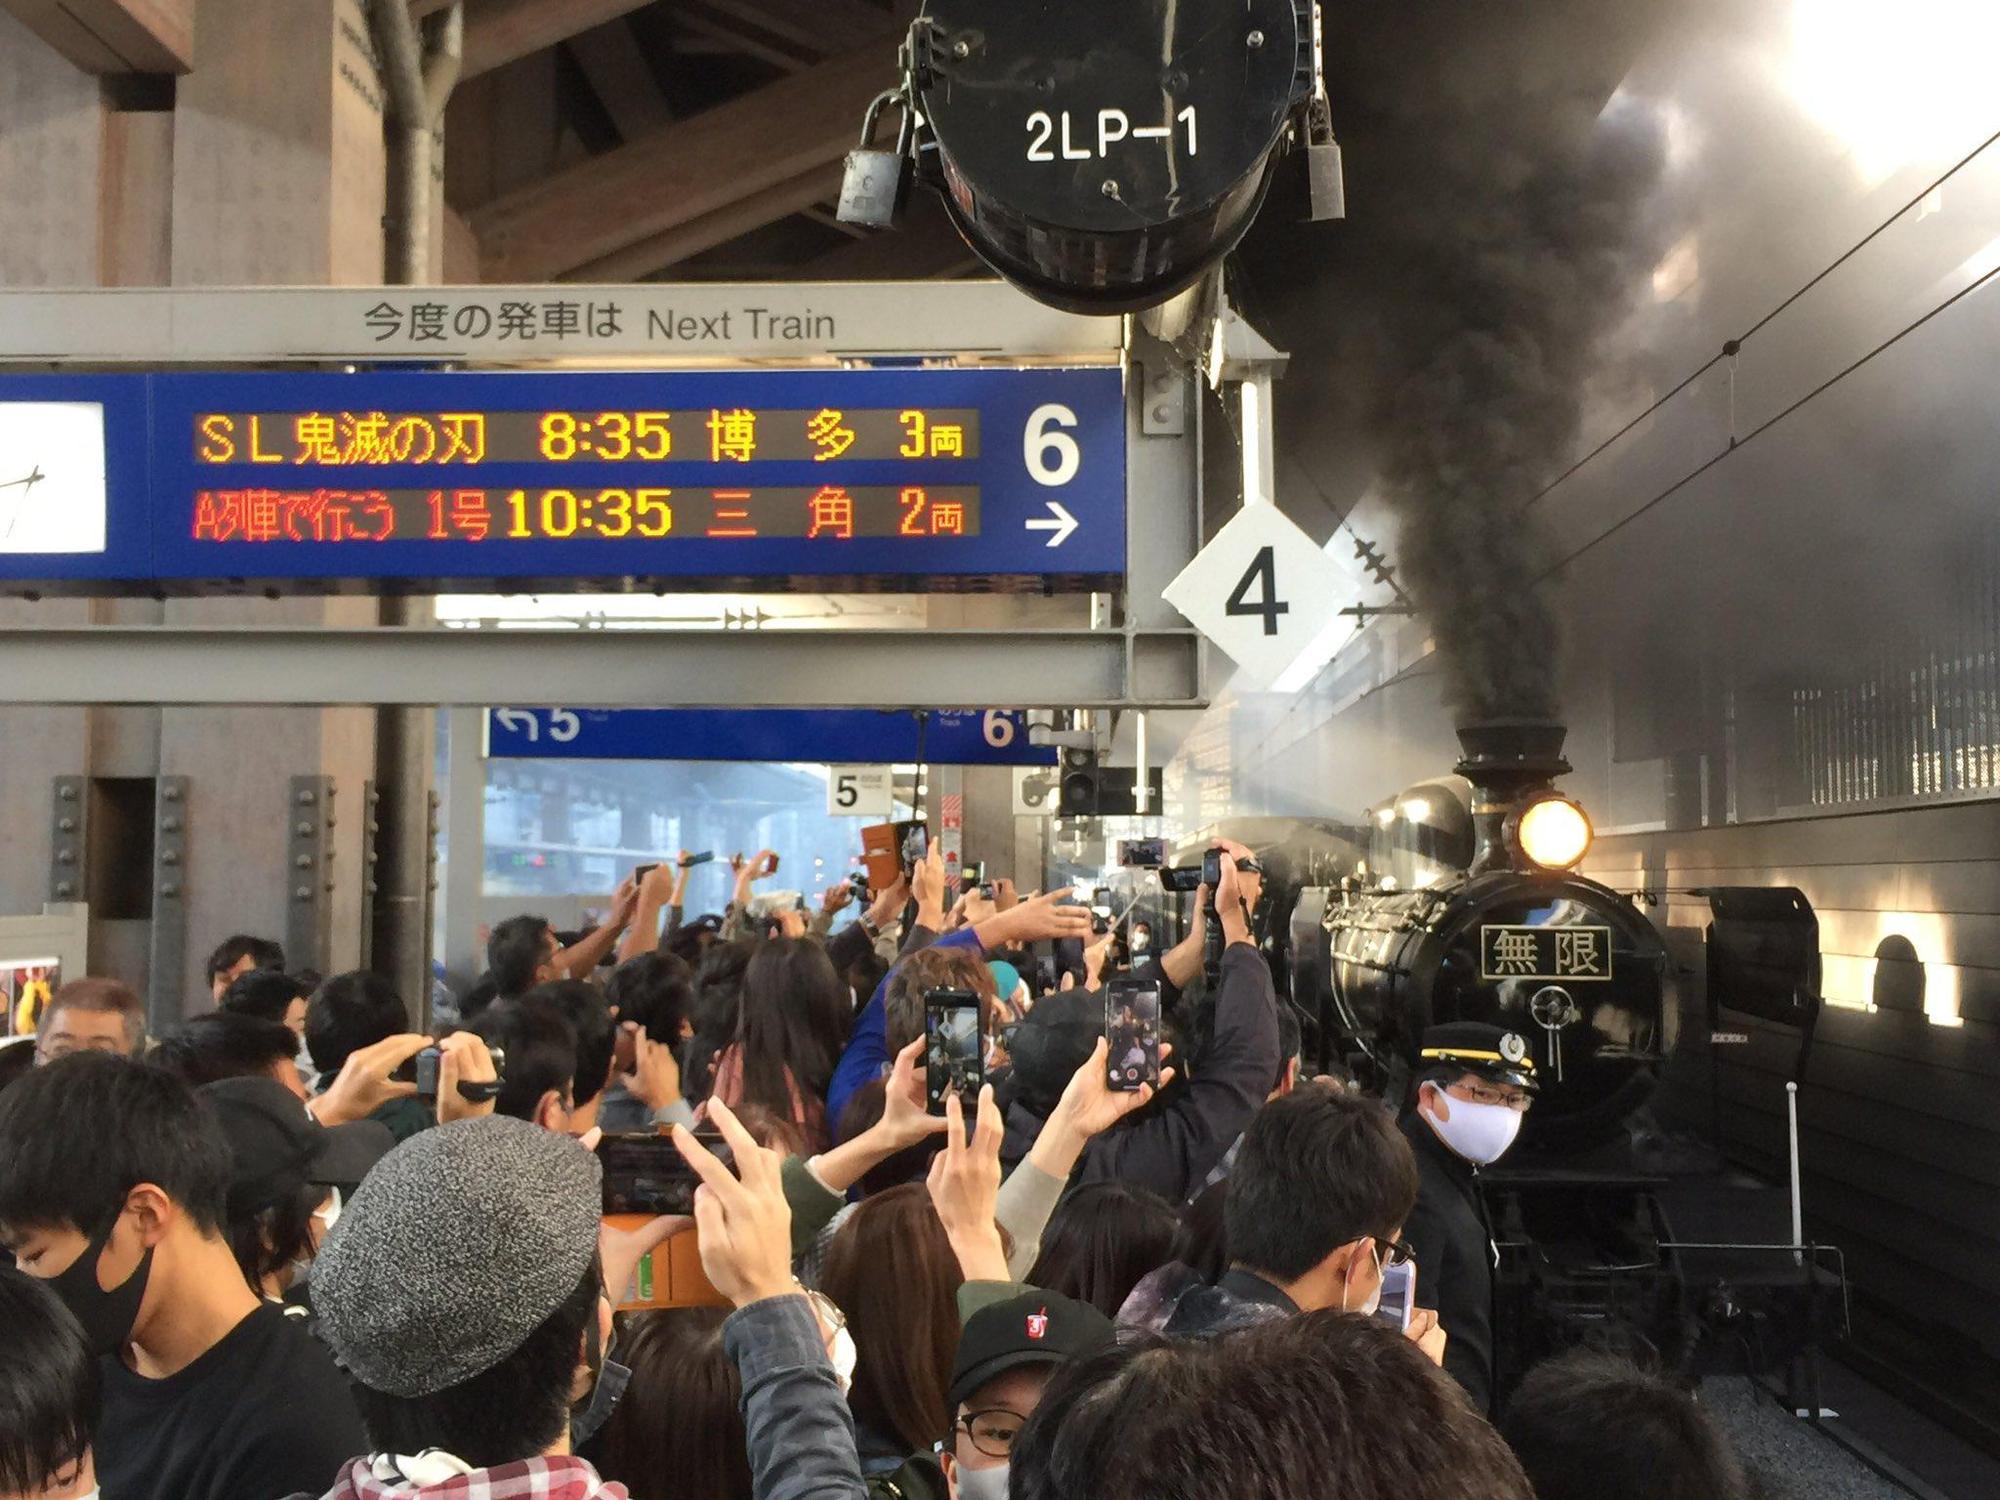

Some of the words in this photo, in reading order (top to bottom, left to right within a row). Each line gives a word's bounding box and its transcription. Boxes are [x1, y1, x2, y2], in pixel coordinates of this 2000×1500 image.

[1026, 104, 1197, 162] 2LP-1
[364, 301, 623, 341] 今度の発車は
[648, 309, 731, 340] Next
[744, 308, 835, 340] Train
[539, 411, 672, 461] 8:35
[899, 409, 964, 459] 3両
[1023, 403, 1081, 487] 6
[427, 488, 492, 541] 1号
[505, 488, 673, 538] 10:35
[899, 487, 964, 536] 2両
[1225, 545, 1289, 636] 4
[549, 708, 581, 743] 5
[982, 709, 1015, 748] 6
[836, 774, 858, 808] 5
[1493, 928, 1600, 975] 無限
